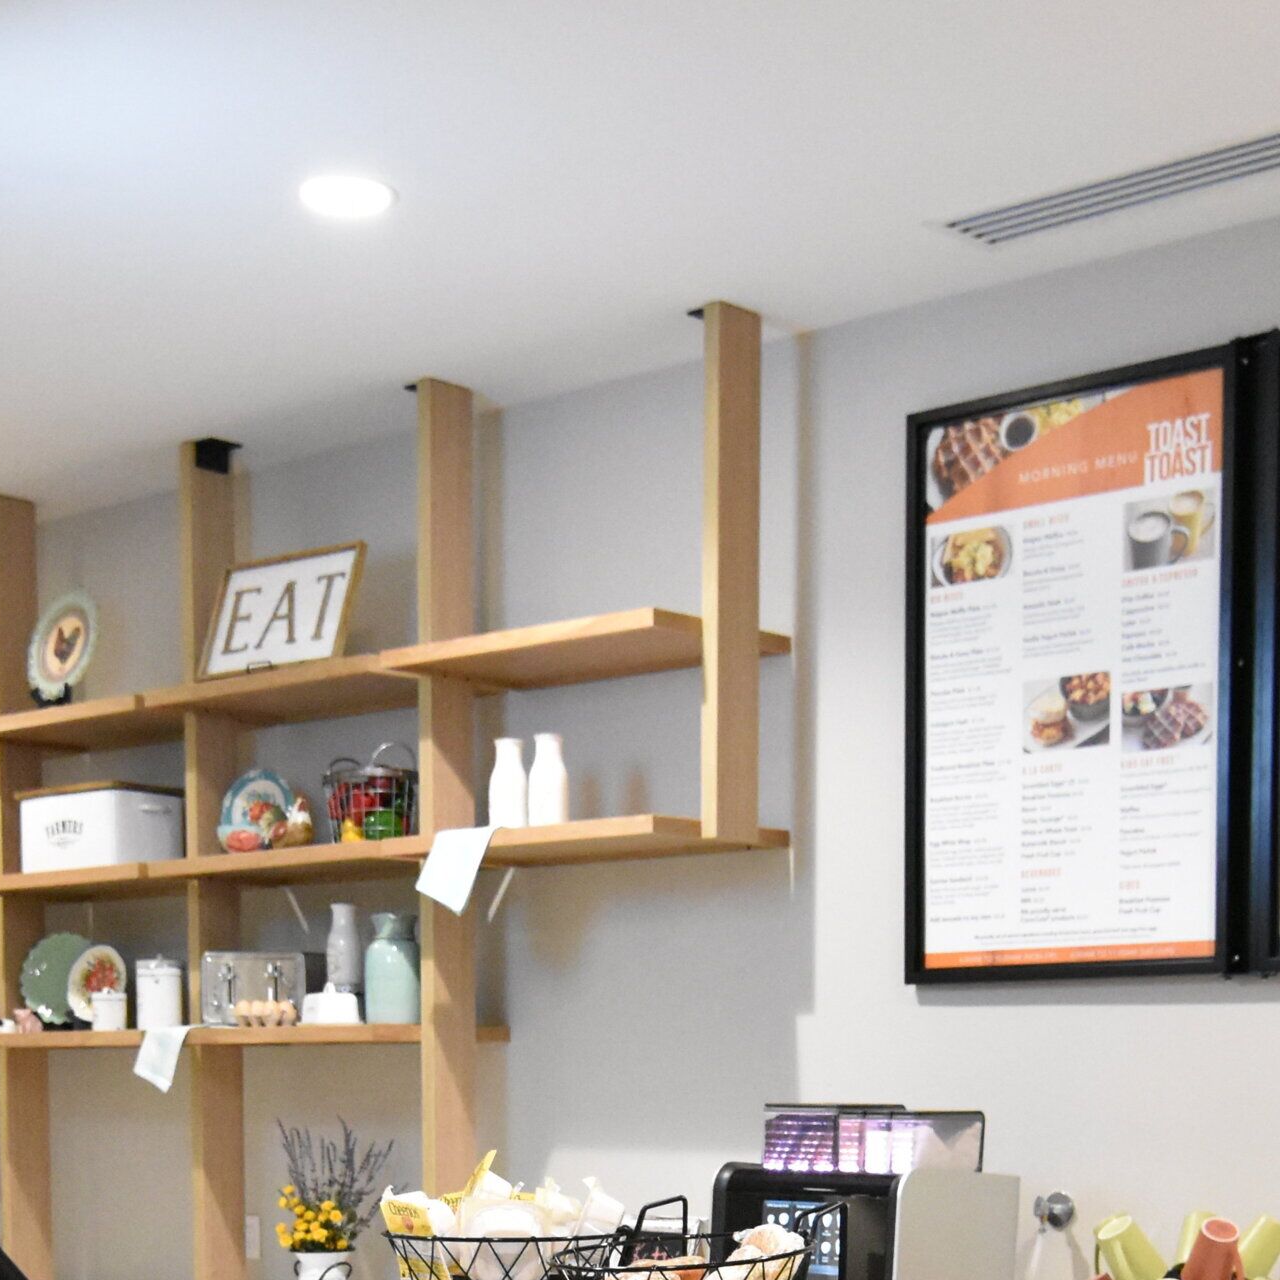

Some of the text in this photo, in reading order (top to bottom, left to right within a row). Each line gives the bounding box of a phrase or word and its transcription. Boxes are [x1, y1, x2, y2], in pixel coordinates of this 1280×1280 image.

[1147, 412, 1211, 453] TOAST
[1018, 450, 1139, 484] MORNING MENU
[1145, 446, 1210, 484] TOAST
[221, 571, 346, 655] EAT
